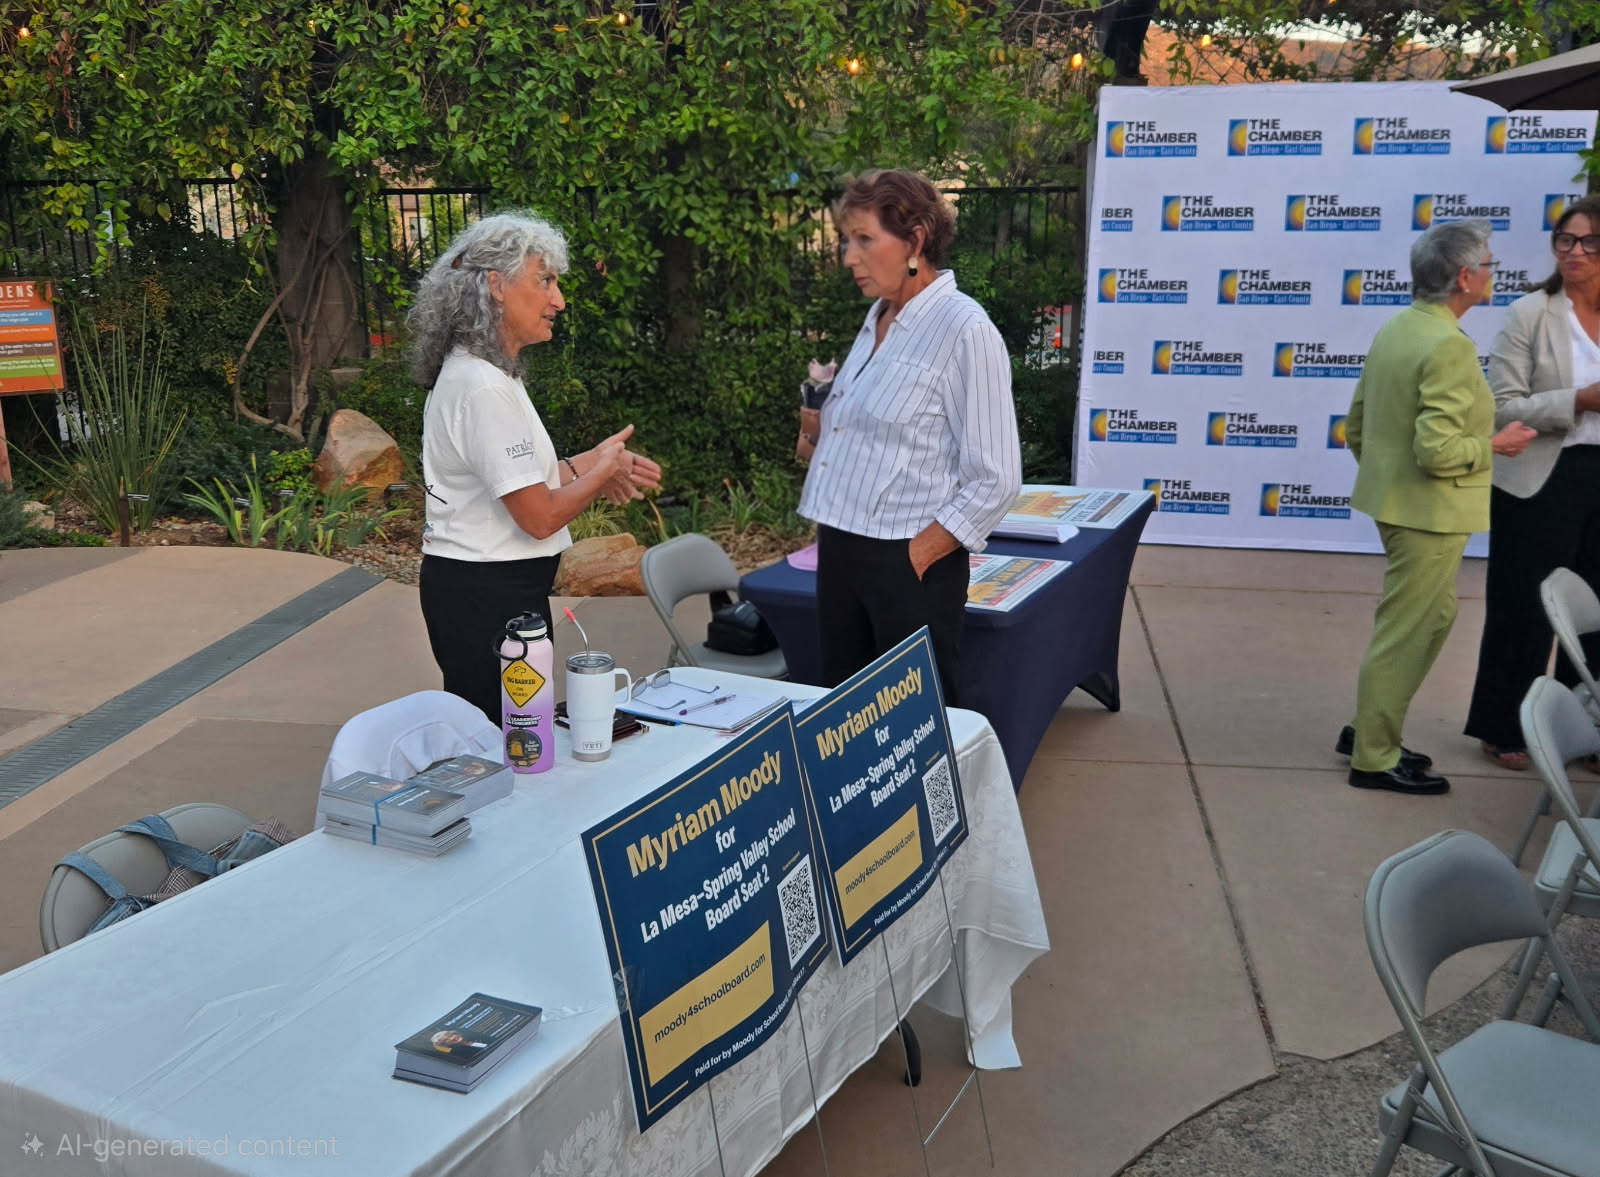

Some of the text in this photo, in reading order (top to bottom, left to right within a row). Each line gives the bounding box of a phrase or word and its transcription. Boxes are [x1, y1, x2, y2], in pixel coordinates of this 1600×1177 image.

[1126, 121, 1156, 132] THE
[1250, 119, 1280, 130] THE
[1376, 118, 1408, 128] THE
[1510, 116, 1542, 126] THE
[1125, 132, 1197, 144] CHAMBER
[1248, 130, 1322, 142] CHAMBER
[1374, 129, 1450, 140] CHAMBER
[1508, 128, 1587, 139] CHAMBER
[1182, 196, 1214, 206] THE
[1308, 195, 1339, 206] THE
[1435, 194, 1468, 204] THE
[1102, 208, 1132, 218] BER
[1181, 207, 1254, 218] CHAMBER
[1306, 207, 1381, 218] CHAMBER
[1434, 206, 1510, 217] CHAMBER
[1118, 269, 1148, 279] THE
[1240, 270, 1270, 280] THE
[1364, 270, 1396, 280] THE
[1494, 270, 1528, 280] THE
[1117, 280, 1188, 290] CHAMBER
[1238, 281, 1311, 292] CHAMBER
[1362, 282, 1410, 292] CHAM
[1173, 341, 1203, 352] THE
[1295, 343, 1326, 353] THE
[1094, 350, 1124, 361] BER
[1172, 352, 1242, 363] CHAMBER
[1294, 354, 1366, 365] CHAMBER
[1108, 409, 1138, 420] THE
[1228, 412, 1258, 424] THE
[1108, 420, 1178, 431] CHAMBER
[1226, 424, 1298, 435] CHAMBER
[1163, 480, 1192, 490] THE
[1281, 484, 1312, 494] THE
[1160, 490, 1230, 502] CHAMBER
[1280, 494, 1352, 506] CHAMBER
[816, 666, 922, 760] Myriam Moody
[874, 725, 890, 746] for
[829, 796, 842, 814] La
[893, 736, 916, 762] Valley
[913, 714, 936, 745] School
[870, 776, 896, 808] Board
[894, 763, 912, 788] Seat
[910, 758, 917, 774] 2
[626, 750, 781, 878] Myriam Moody
[716, 826, 736, 854] for
[845, 830, 915, 895] moody4schoolboard.com
[640, 920, 660, 944] La
[740, 836, 769, 870] Valley
[768, 808, 796, 847] School
[705, 863, 770, 931] Board Seat 2
[654, 953, 766, 1043] moody4schoolboard.com
[695, 1060, 710, 1077] Paid
[710, 1055, 722, 1067] for
[722, 1048, 732, 1060] by
[732, 1032, 755, 1053] Moody
[755, 1024, 764, 1036] for
